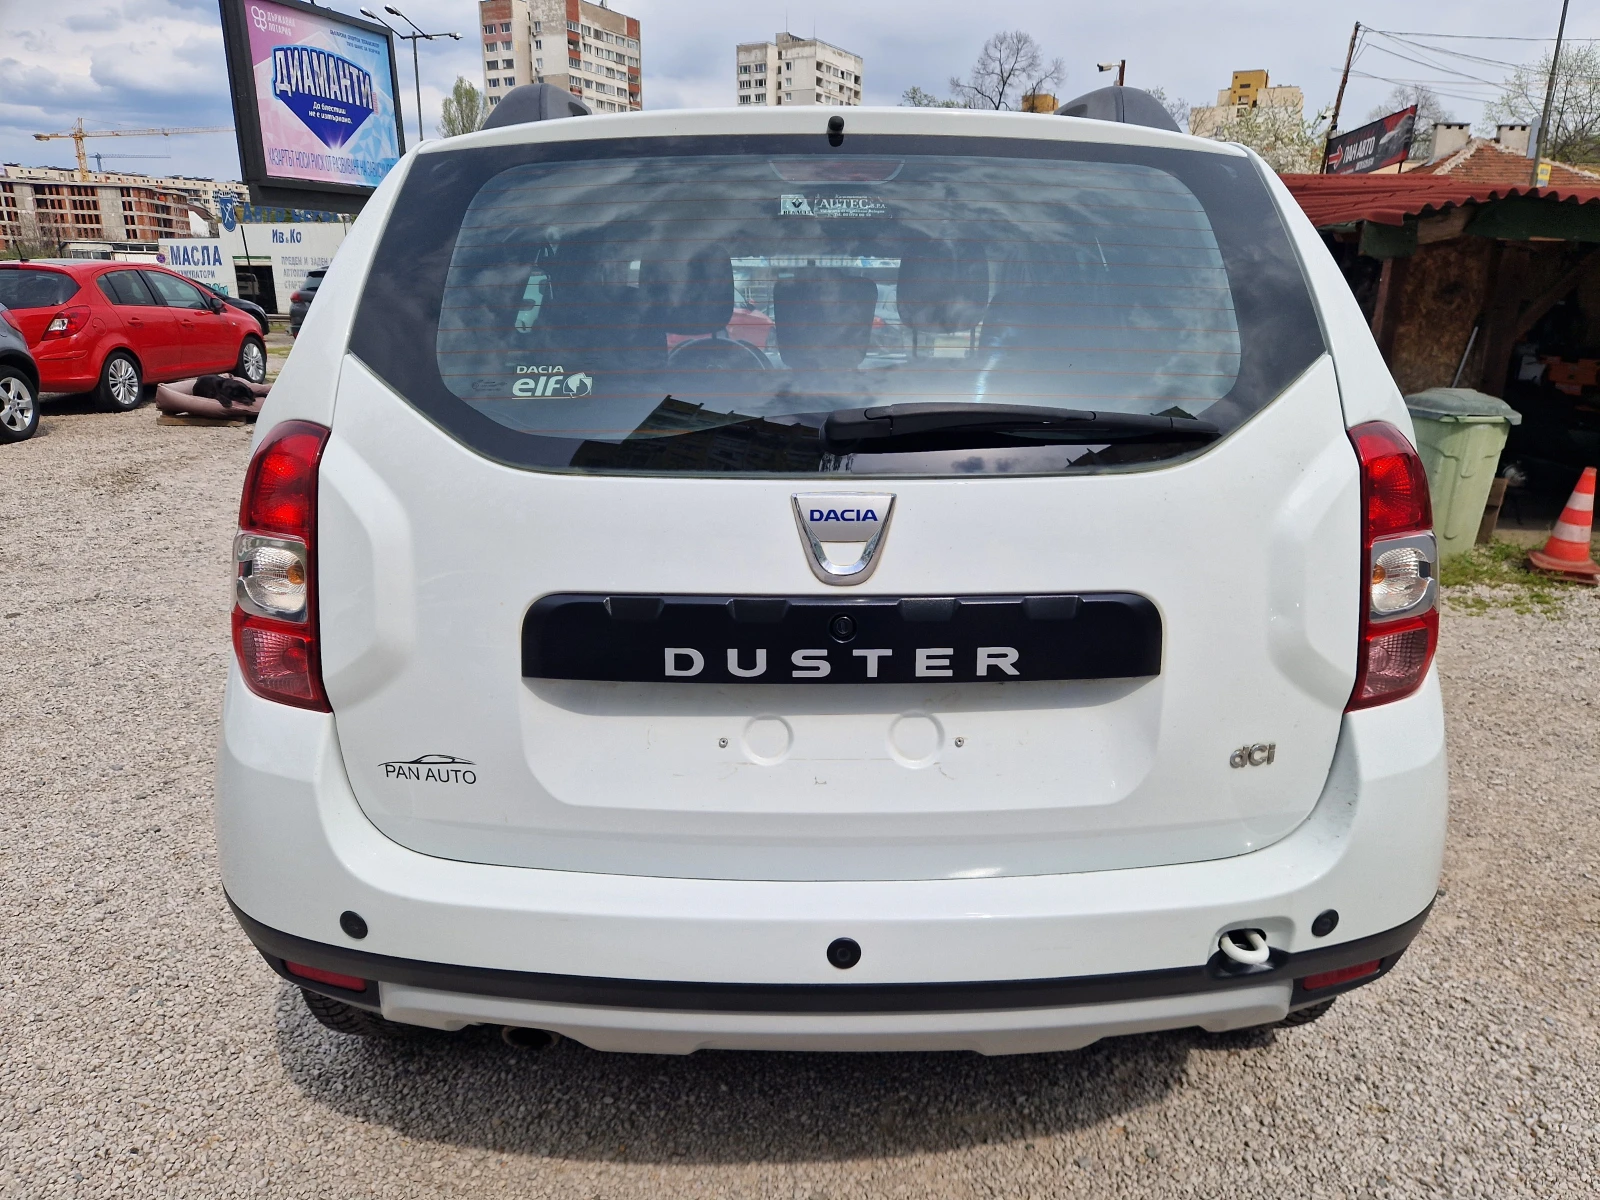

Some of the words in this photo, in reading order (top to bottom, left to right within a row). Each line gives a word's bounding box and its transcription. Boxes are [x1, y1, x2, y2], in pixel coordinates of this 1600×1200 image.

[274, 50, 374, 110] ДИАМАНТИ
[312, 101, 321, 111] Да
[267, 147, 295, 167] ХАЗАРТЪТ
[295, 151, 311, 169] НОСИ
[1356, 136, 1376, 159] АВТО
[272, 229, 285, 243] Ив
[290, 228, 302, 243] Ко
[169, 245, 222, 266] МАСЛА
[284, 279, 304, 289] СТАРТ
[516, 365, 565, 374] DACIA
[512, 375, 564, 397] elf
[809, 509, 878, 522] DACIA
[664, 646, 1021, 678] DUSTER
[384, 764, 421, 781] PAN
[425, 767, 477, 785] AUTO
